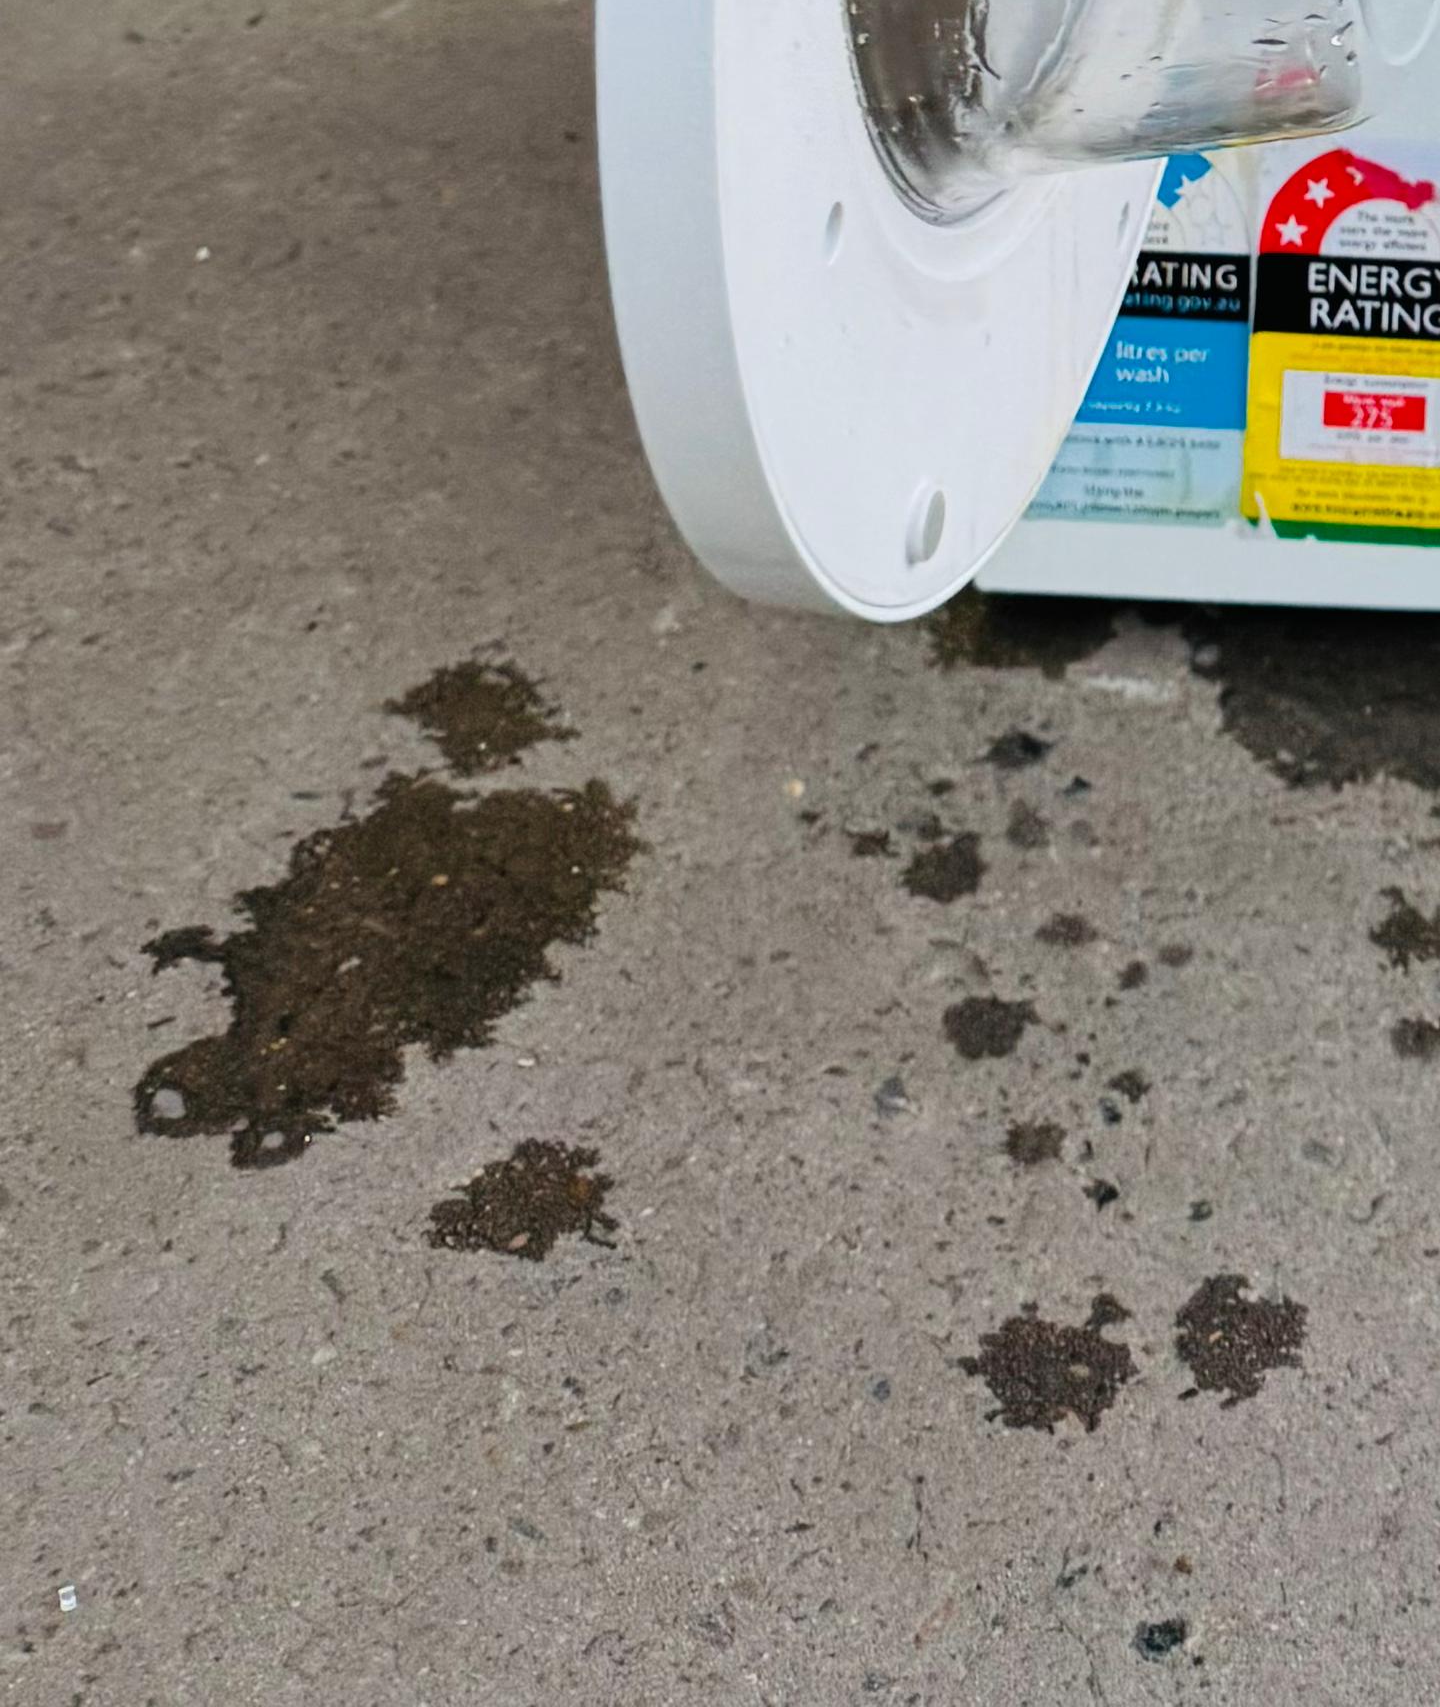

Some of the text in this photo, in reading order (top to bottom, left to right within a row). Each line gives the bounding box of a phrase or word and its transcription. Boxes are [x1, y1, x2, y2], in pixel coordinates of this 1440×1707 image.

[1358, 209, 1379, 222] The
[1124, 290, 1241, 313] ating.gov.au
[1116, 340, 1210, 364] litres per
[1116, 365, 1170, 384] wash
[1350, 404, 1394, 430] 275
